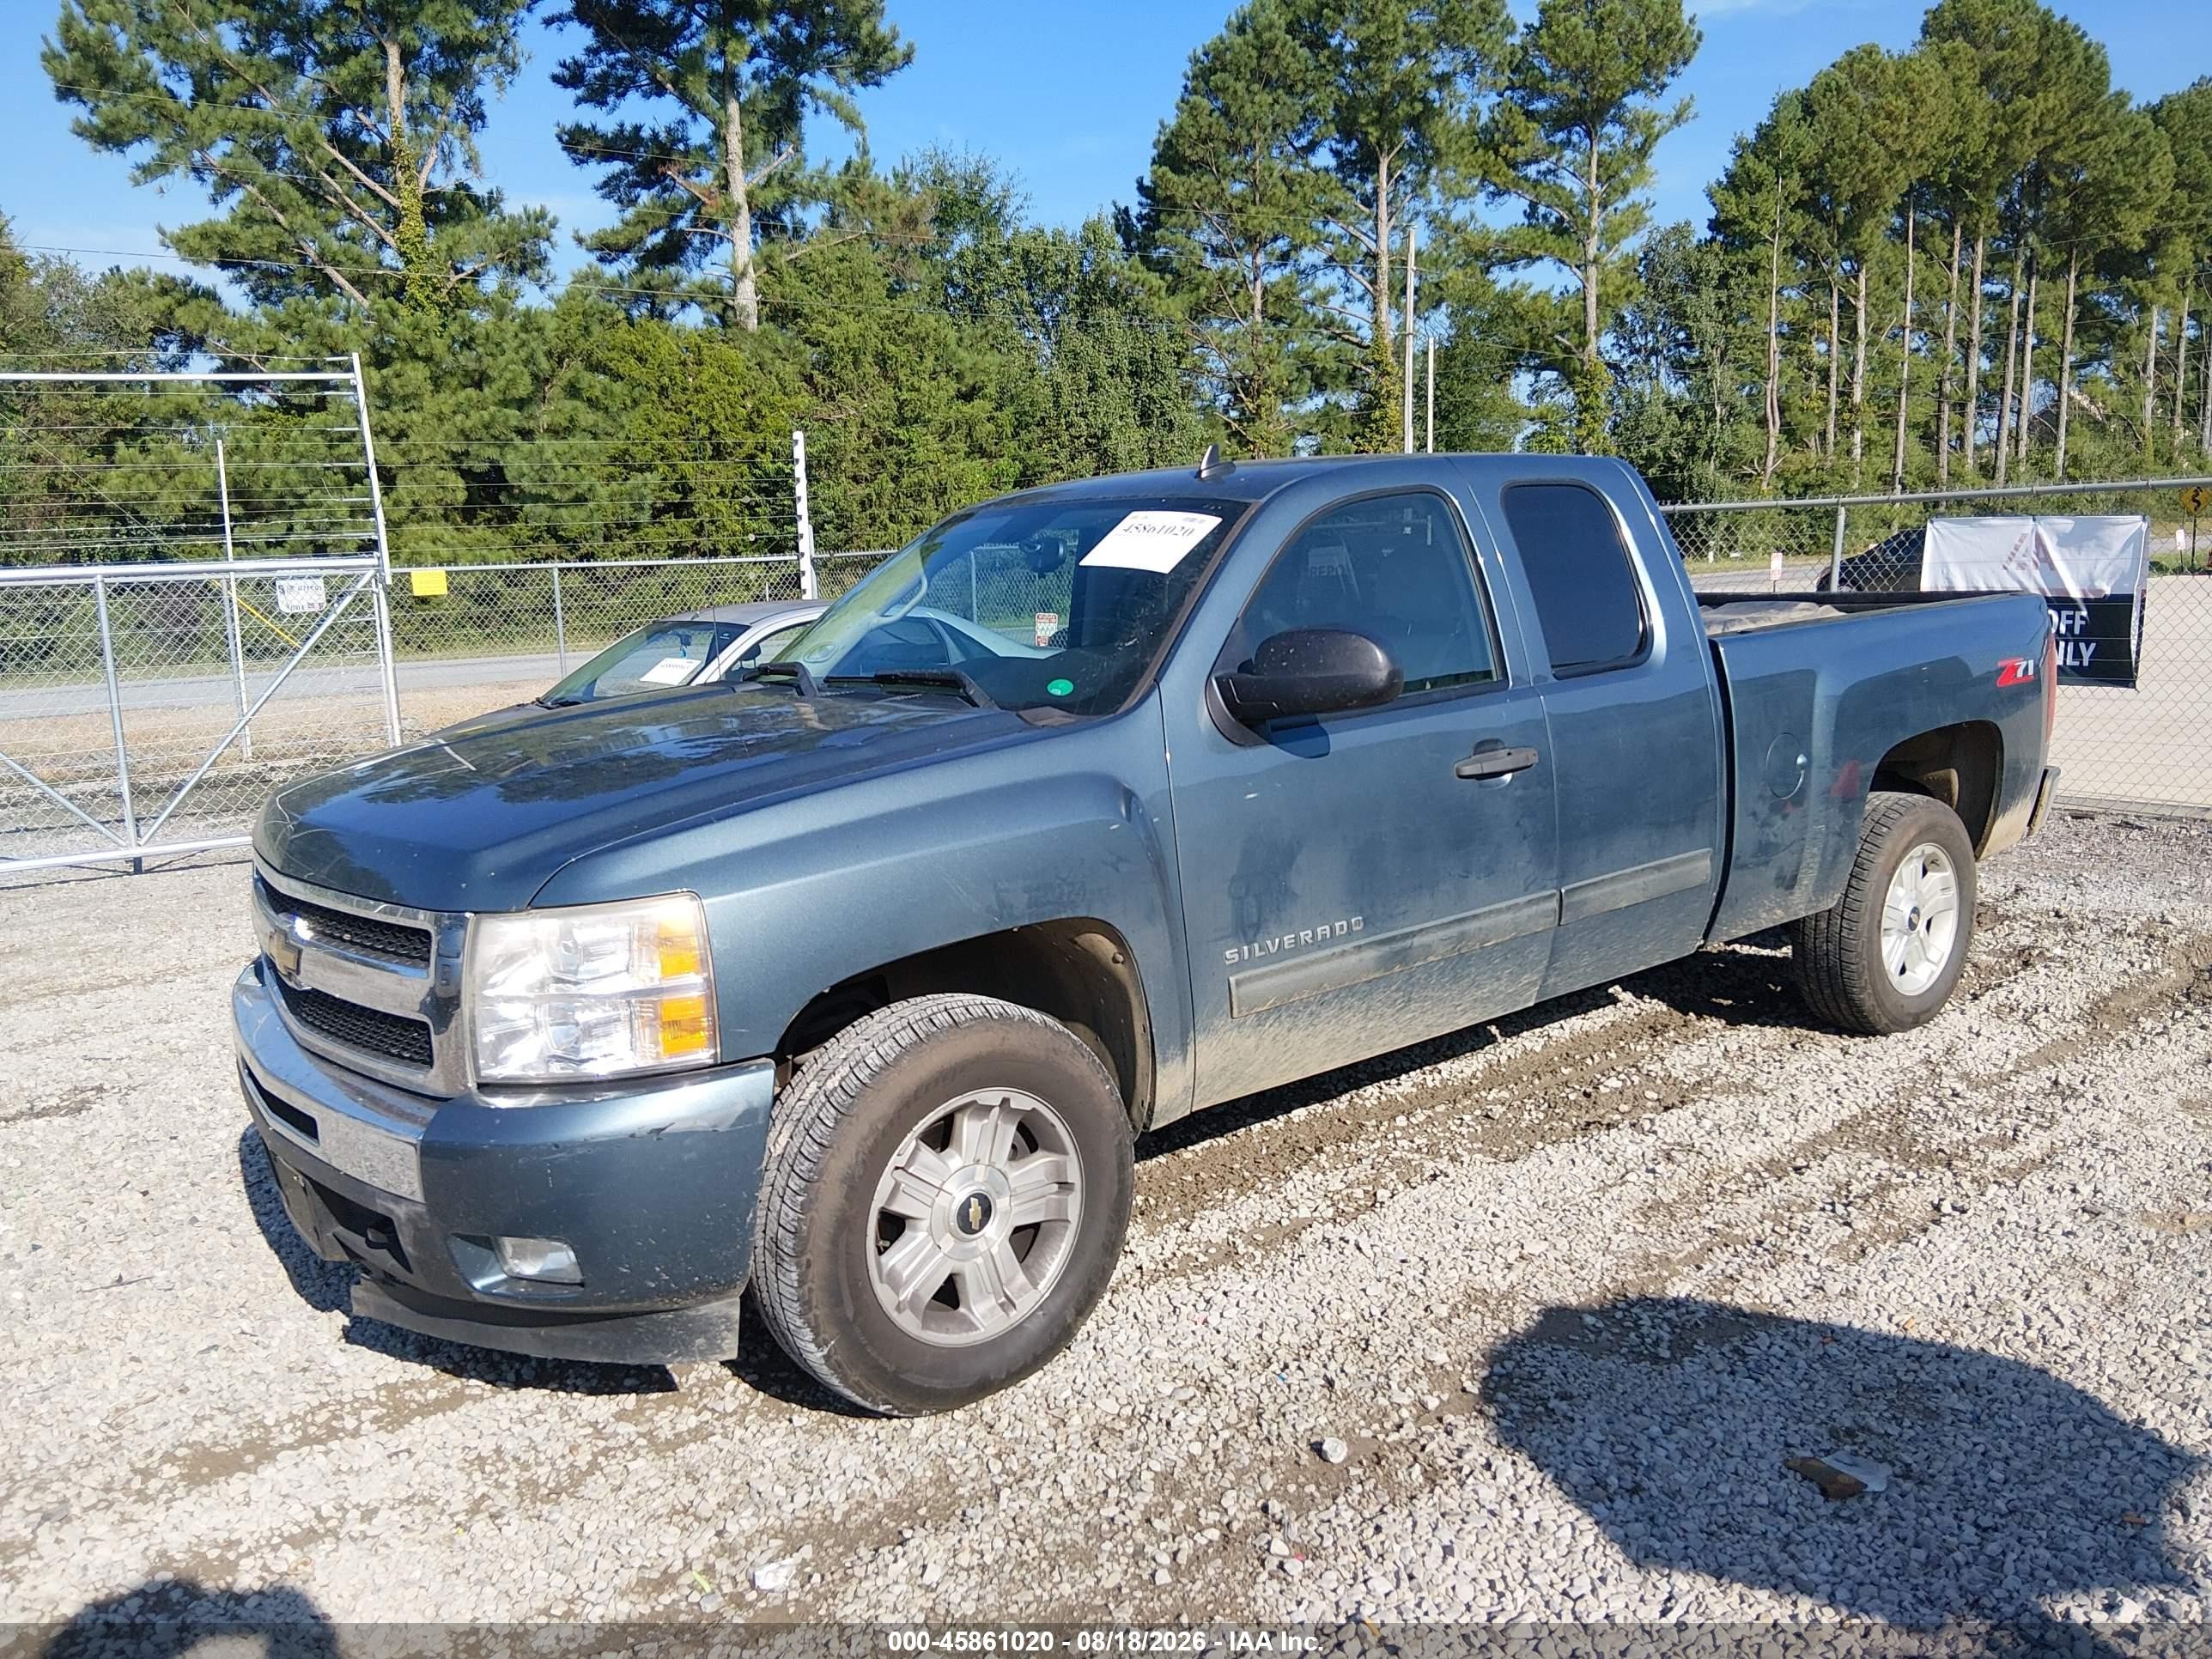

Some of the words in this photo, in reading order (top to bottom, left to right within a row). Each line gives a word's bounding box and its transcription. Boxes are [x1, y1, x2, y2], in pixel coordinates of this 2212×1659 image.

[1122, 522, 1195, 538] 45861020
[2047, 609, 2087, 635] OFF
[2054, 641, 2097, 667] NLY
[1996, 657, 2034, 688] Z71
[1224, 915, 1365, 965] SILVERADO
